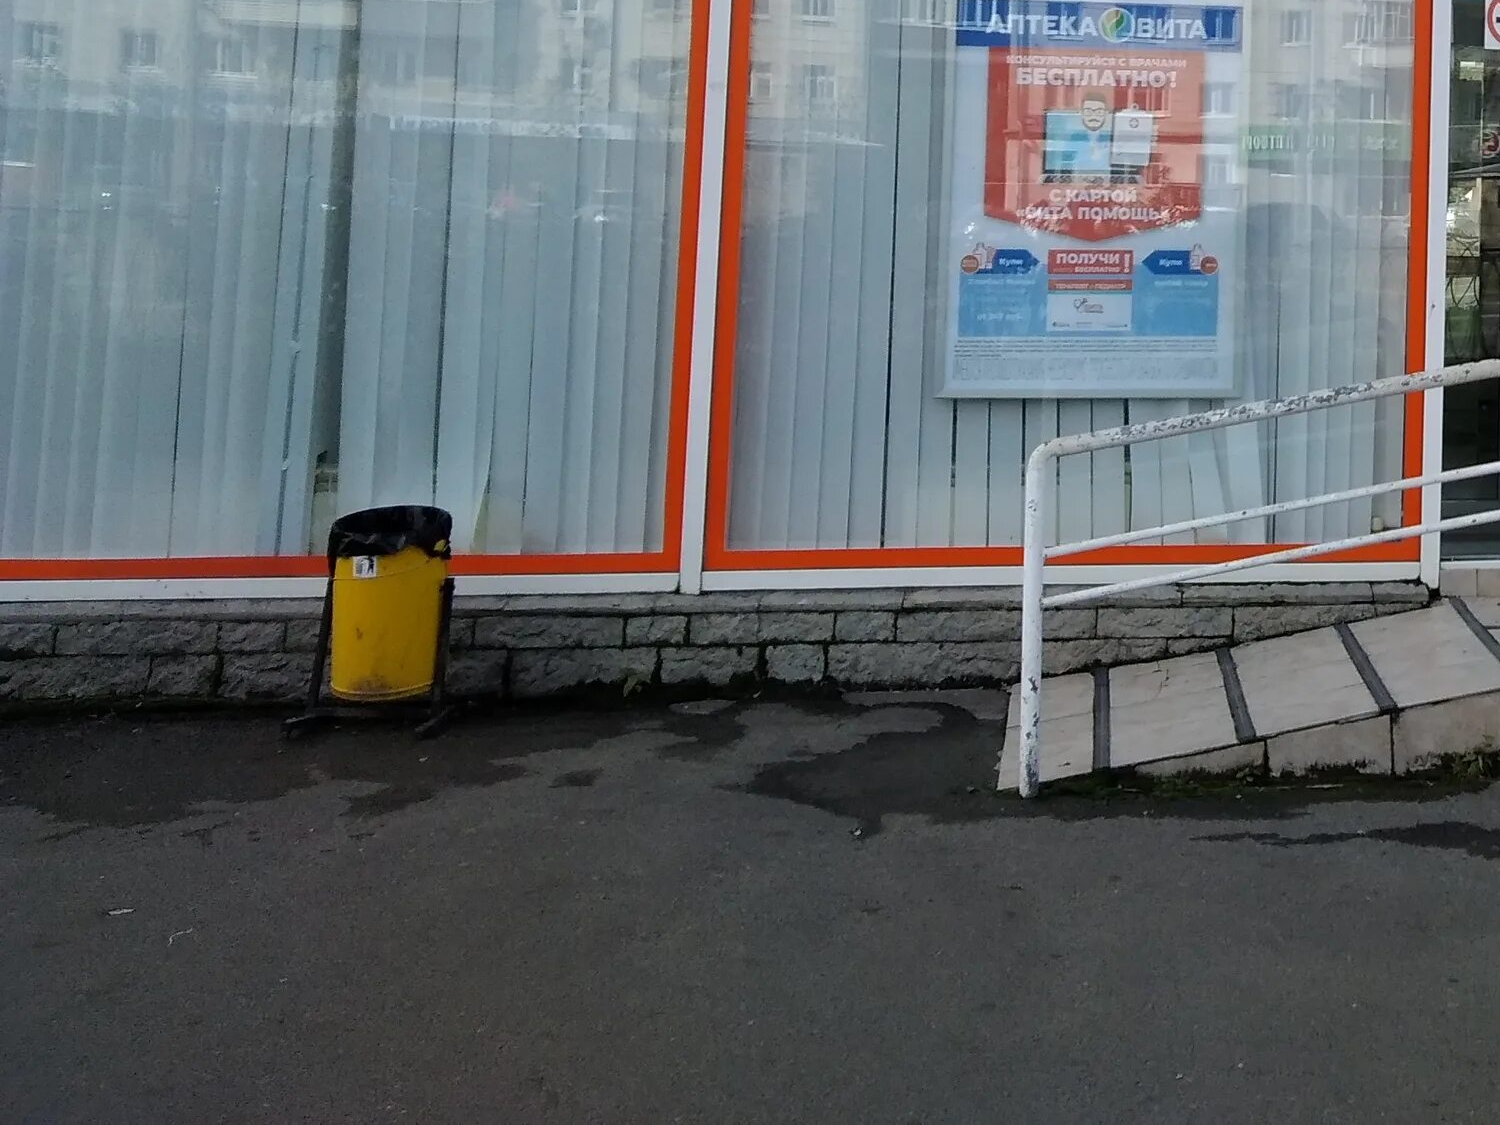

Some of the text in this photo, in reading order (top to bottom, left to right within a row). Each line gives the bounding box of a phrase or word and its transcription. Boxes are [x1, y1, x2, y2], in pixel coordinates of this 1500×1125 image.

[986, 13, 1208, 40] АПТЕКА ВИТА
[1006, 55, 1116, 67] КОНСУЛЬТИРУЙСЯ
[1129, 57, 1187, 69] ВРАЧАМИ
[1016, 67, 1177, 89] БЕСПЛАТНО!
[1050, 187, 1137, 203] С КАРТОЙ
[1056, 252, 1120, 265] ПОЛУЧИ
